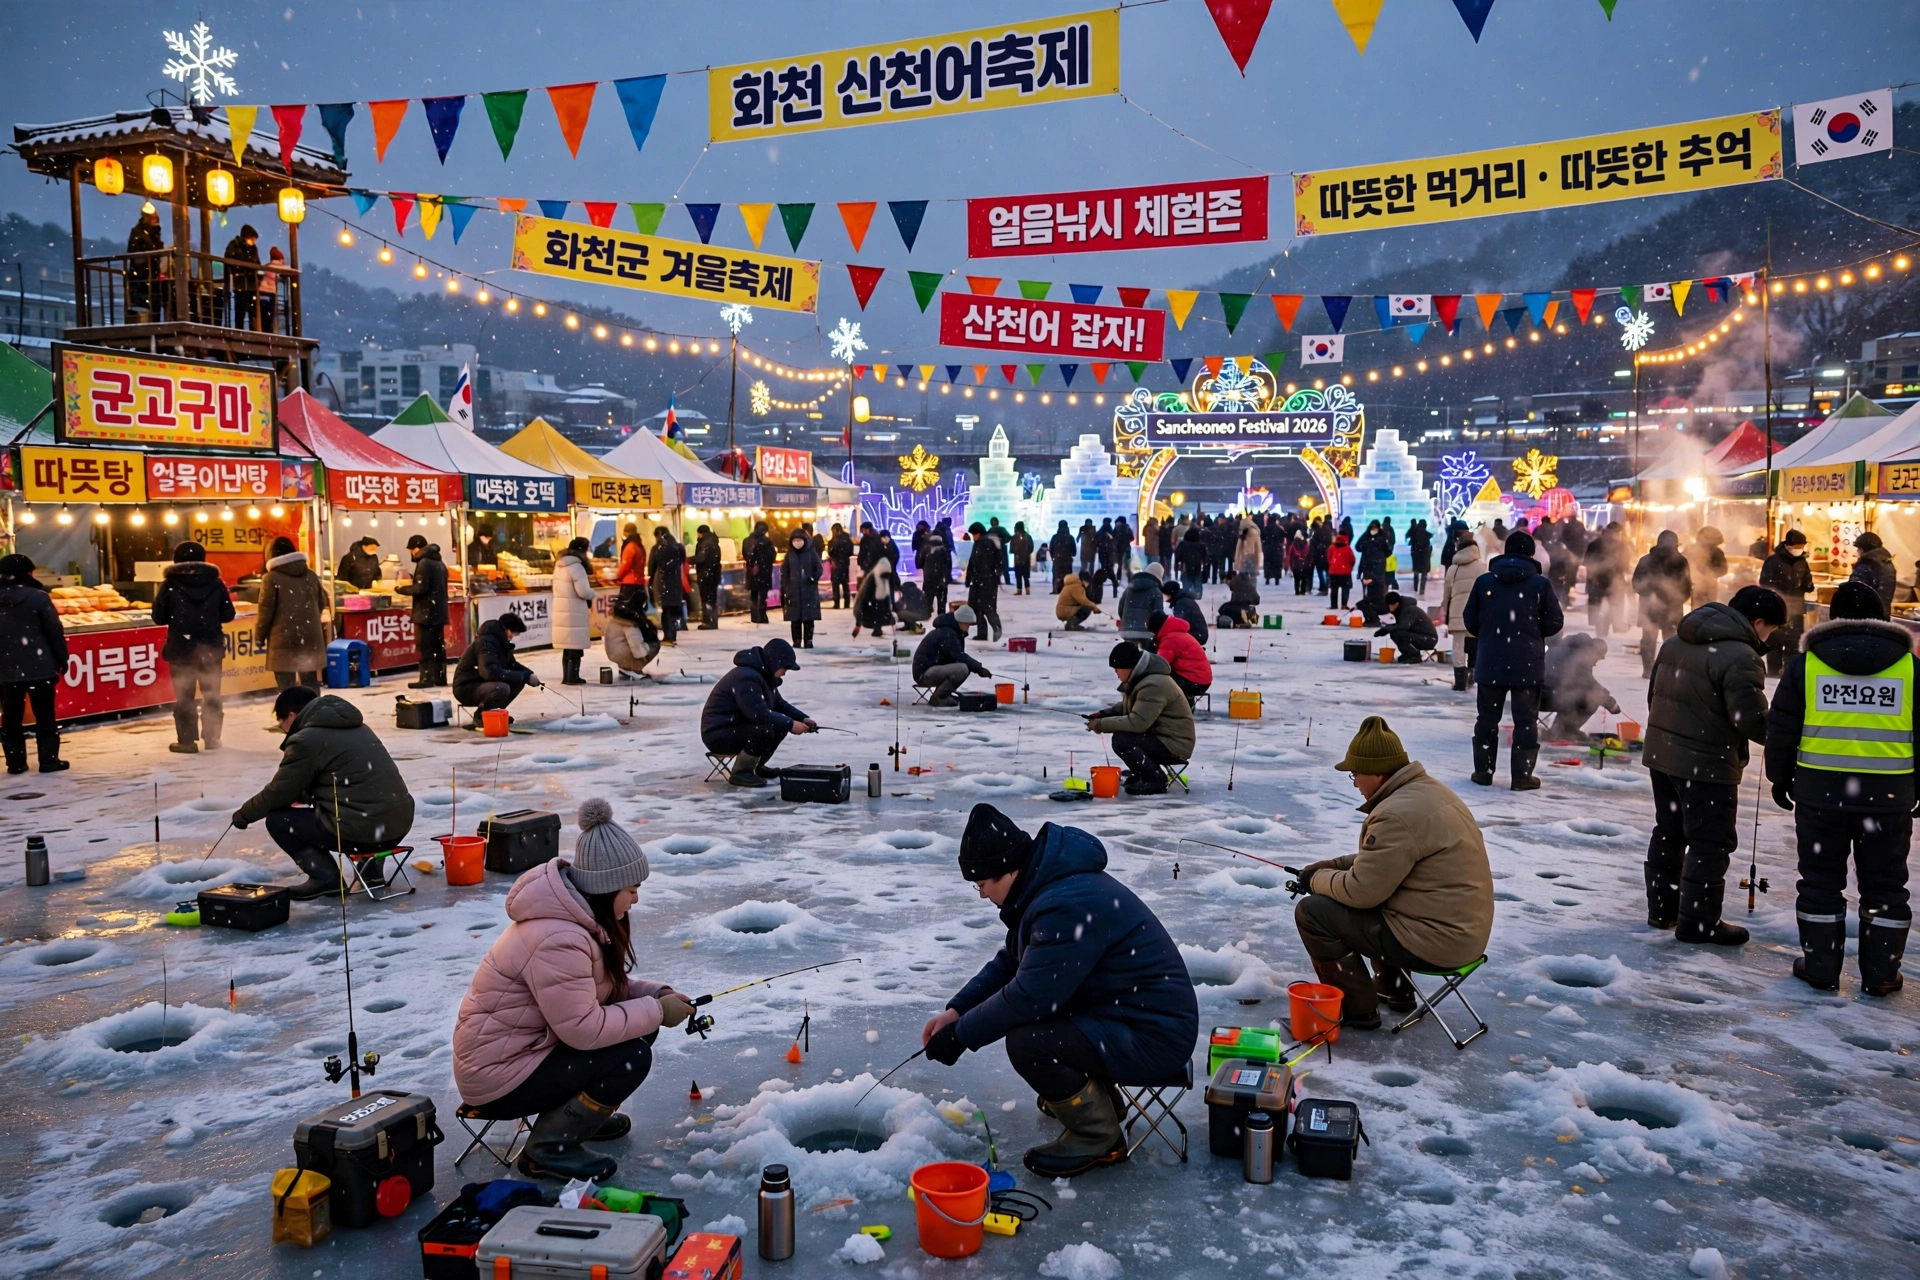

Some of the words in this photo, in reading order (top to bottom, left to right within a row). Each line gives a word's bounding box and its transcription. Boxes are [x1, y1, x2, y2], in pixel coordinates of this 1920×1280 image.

[732, 64, 823, 127] 화천
[836, 23, 1091, 116] 산천어축제
[1319, 172, 1417, 220] 따뜻한
[1426, 159, 1526, 208] 먹거리
[1560, 140, 1668, 192] 따뜻한
[1678, 127, 1753, 178] 추억
[988, 198, 1123, 248] 얼음낚시
[1133, 188, 1243, 237] 체험존
[543, 229, 651, 281] 화천군
[659, 248, 794, 303] 겨울축제
[961, 303, 1061, 348] 산천어
[1069, 312, 1146, 353] 잡자!
[89, 368, 254, 435] 군고구마
[1156, 418, 1236, 435] Sancheoneo
[1239, 417, 1289, 434] Festival
[1292, 417, 1328, 434] 2026
[34, 457, 134, 497] 따뜻탕
[345, 474, 400, 505] 따뜻한
[405, 477, 440, 506] 호떡
[63, 643, 159, 693] 어묵탕
[1822, 683, 1896, 707] 안전요원
